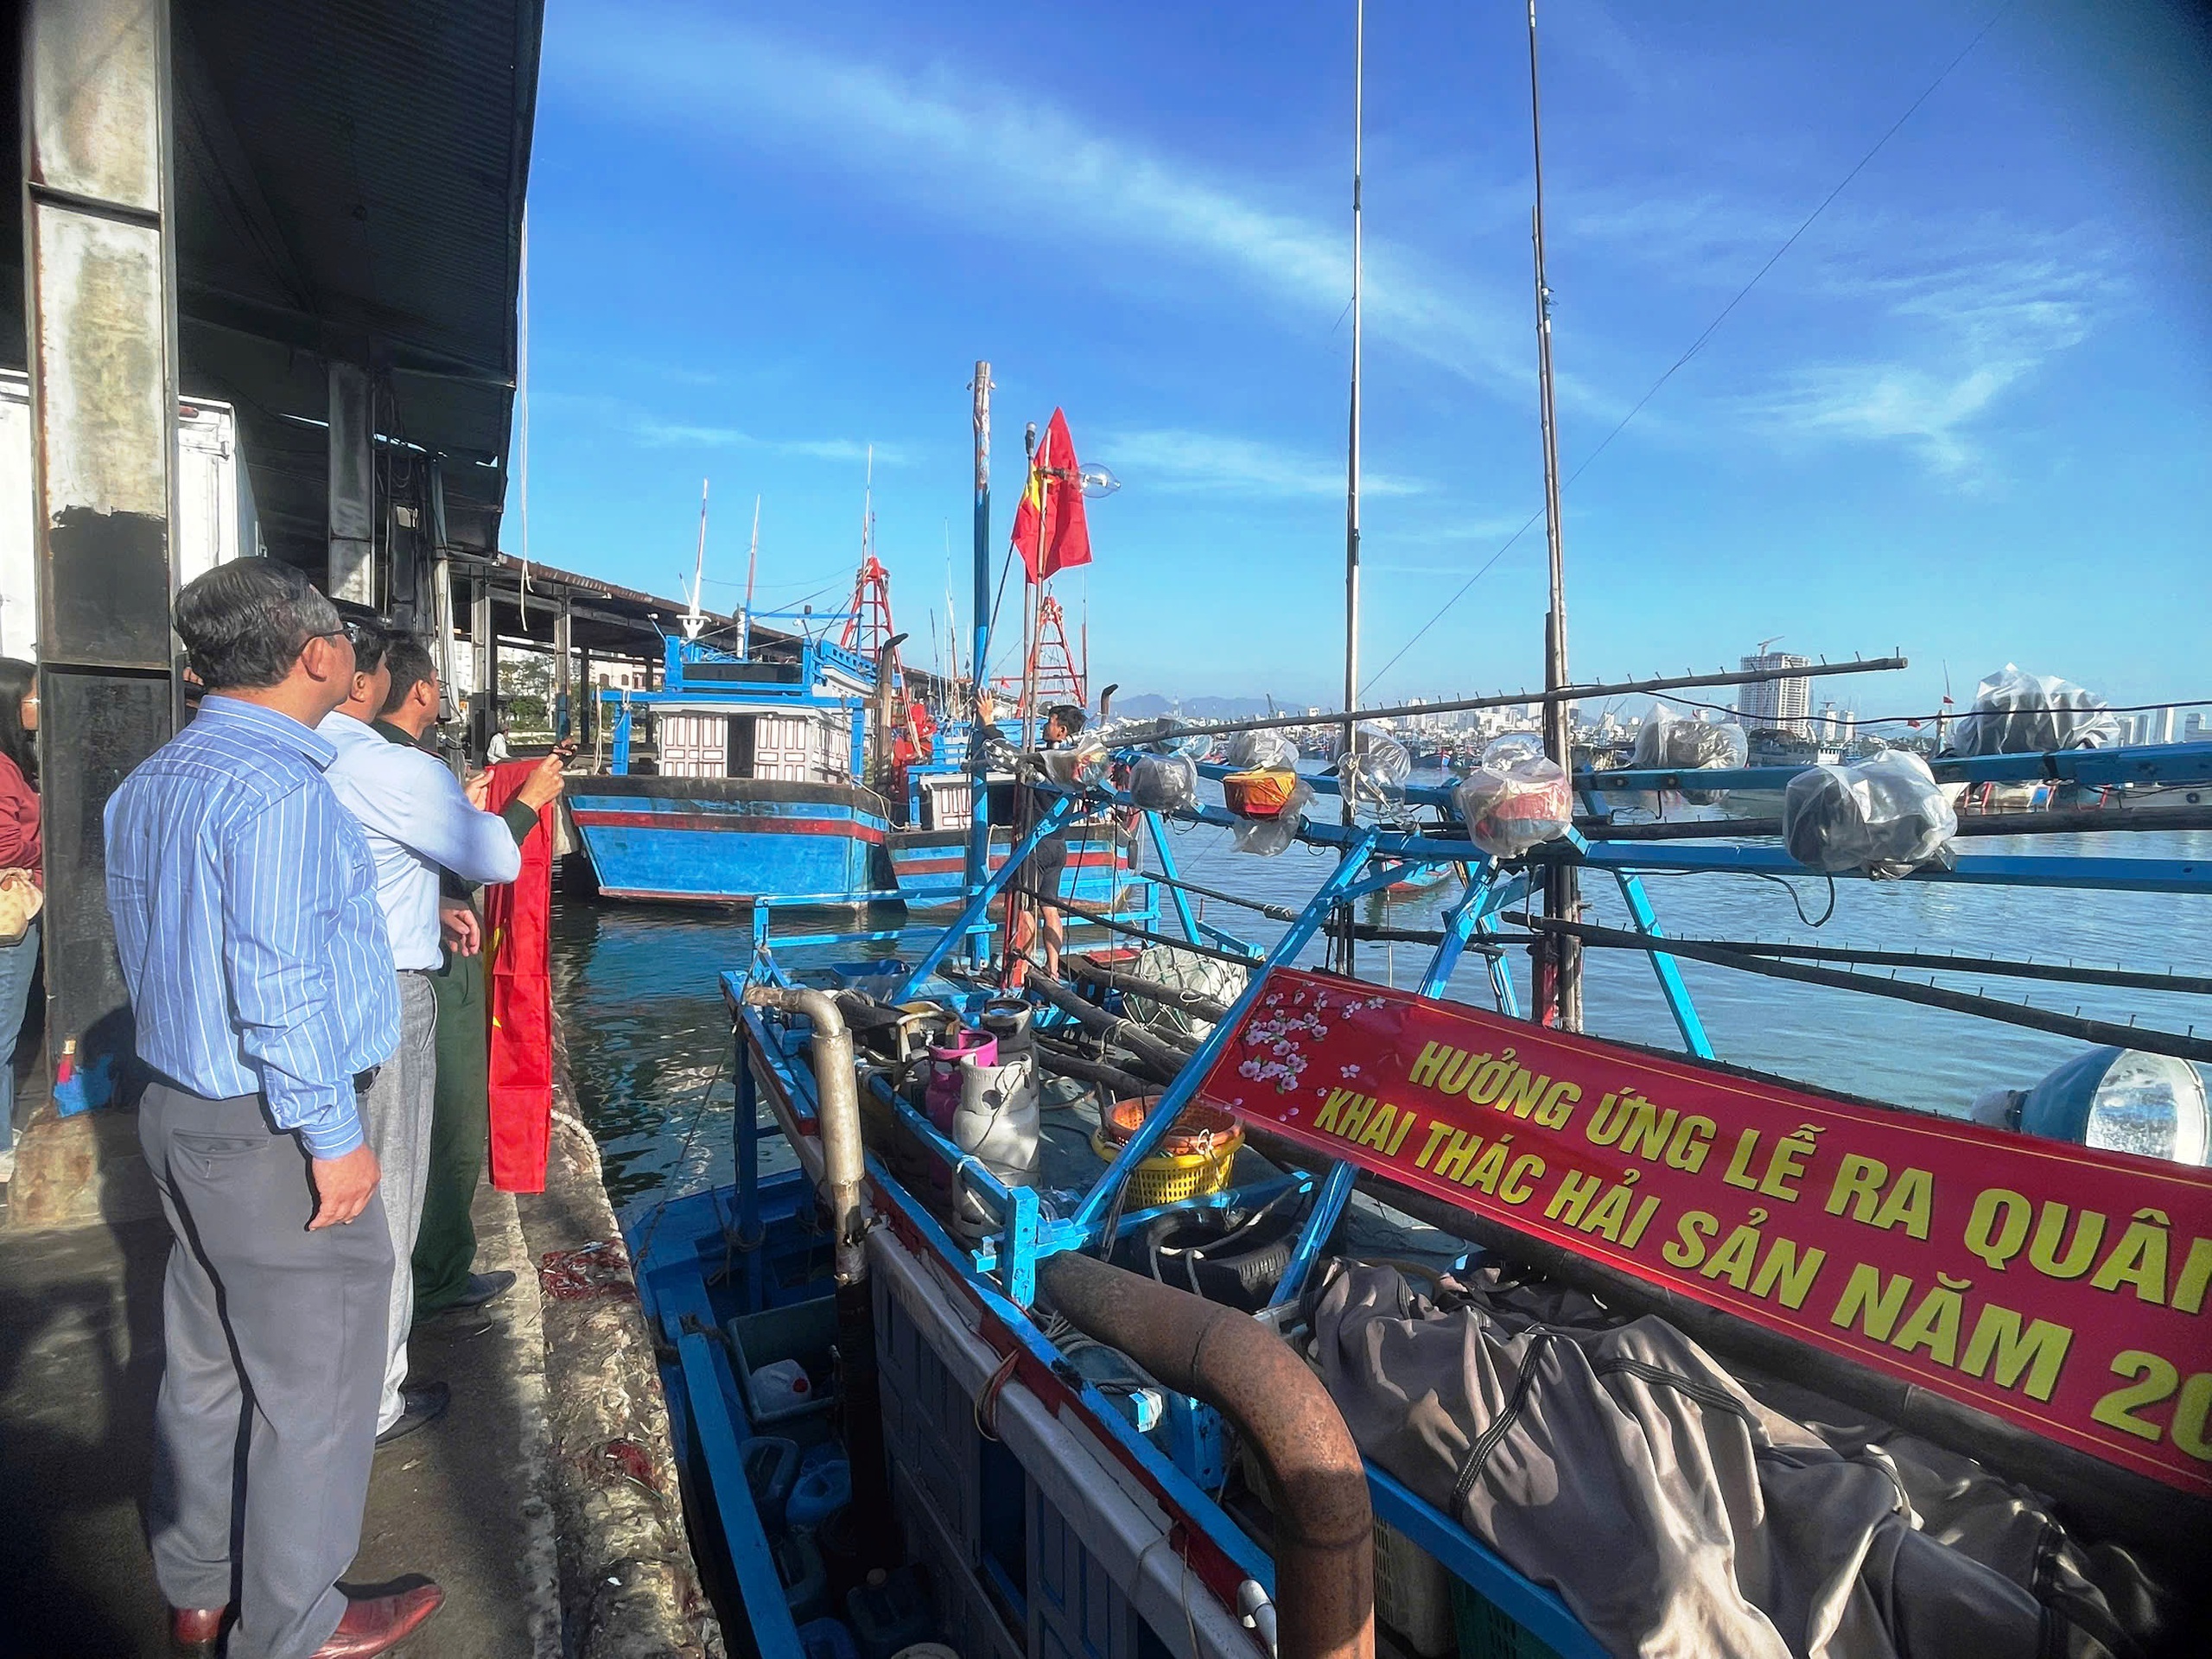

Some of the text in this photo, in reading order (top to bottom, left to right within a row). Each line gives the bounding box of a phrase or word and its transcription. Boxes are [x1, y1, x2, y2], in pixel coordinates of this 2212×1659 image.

[1313, 1087, 1417, 1156] KHAI
[1414, 1121, 1547, 1205] THÁC
[1544, 1167, 1661, 1249] HẢI
[1662, 1207, 1827, 1310] SẢN
[1832, 1263, 2074, 1402] NĂM
[1408, 1041, 1583, 1130] HƯỞNG
[1586, 1087, 1718, 1173] ỨNG
[1723, 1123, 1828, 1202] LỄ
[1826, 1154, 1934, 1240] RA
